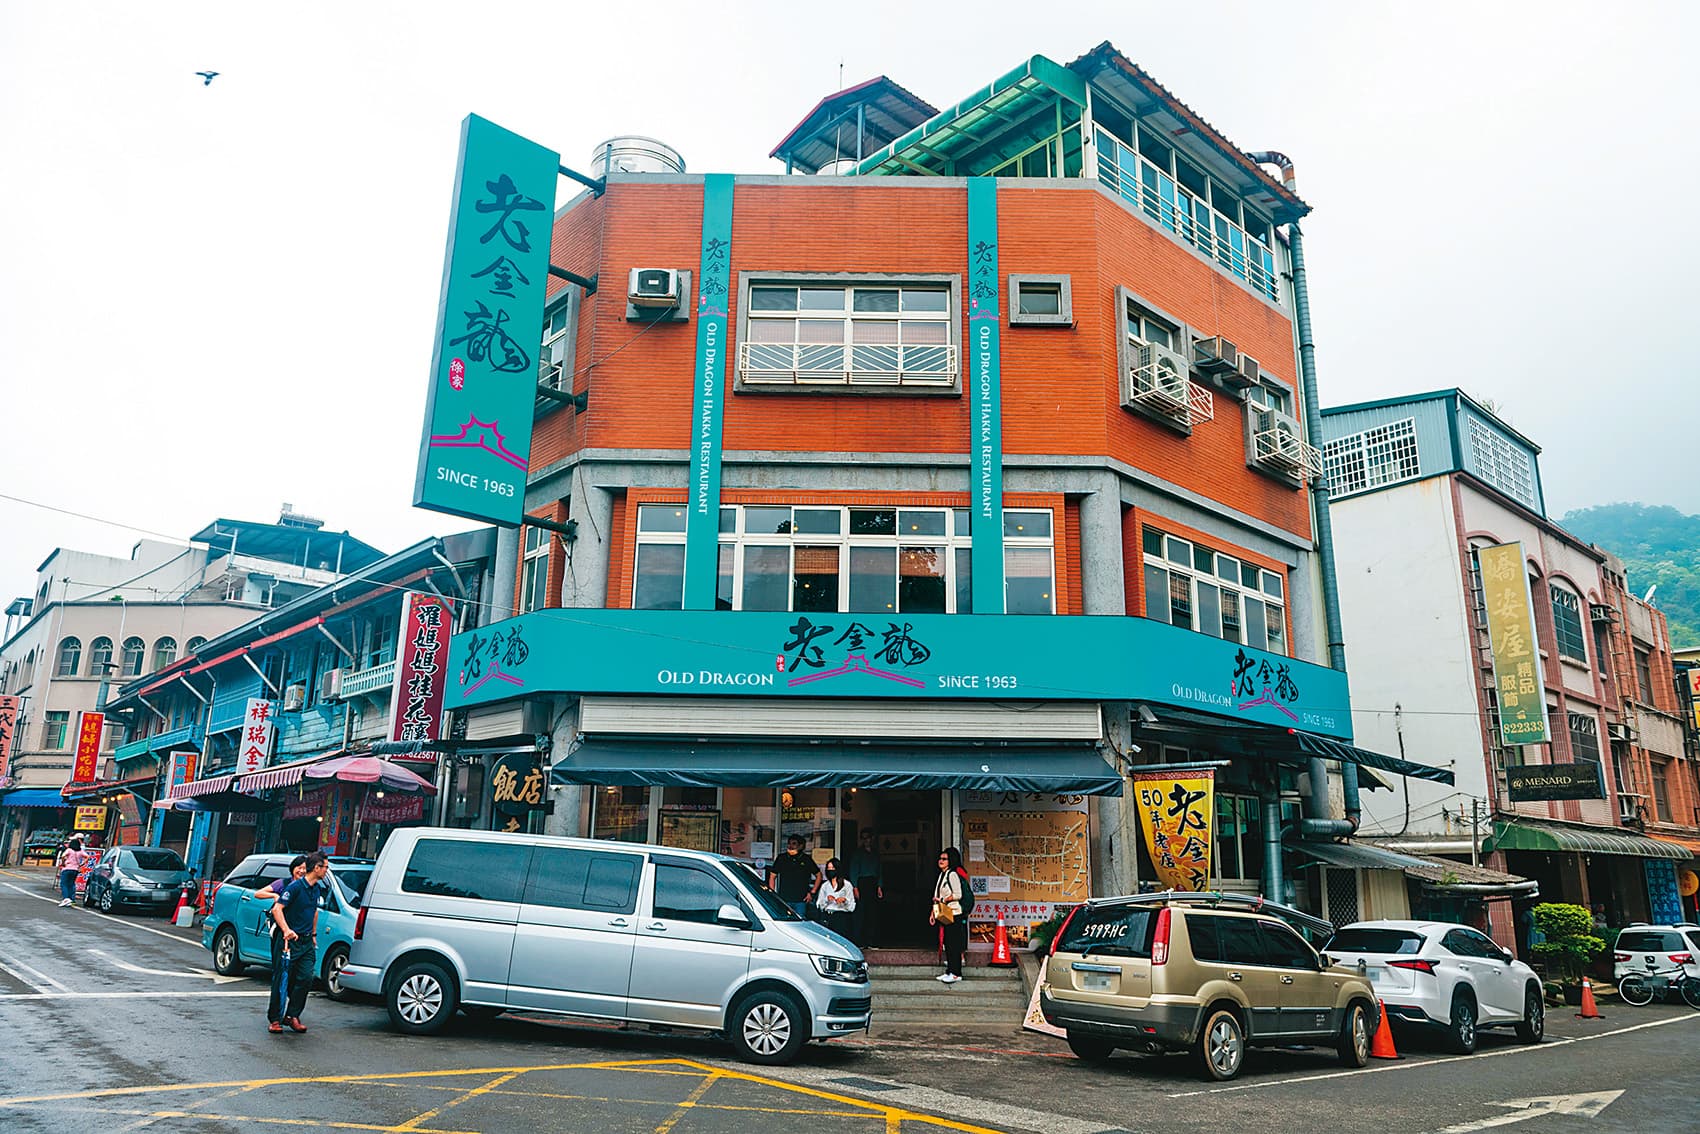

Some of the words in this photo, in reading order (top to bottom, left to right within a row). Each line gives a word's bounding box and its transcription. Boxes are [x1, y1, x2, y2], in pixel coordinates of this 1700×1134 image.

[450, 174, 546, 373] 老金龍
[701, 237, 729, 296] 老金龍
[972, 240, 998, 300] 老金龍
[701, 400, 713, 440] HAKKA
[981, 403, 992, 442] HAKKA
[436, 466, 478, 489] SINCE
[483, 479, 514, 497] 1963
[698, 441, 712, 515] RESTAURANT
[982, 445, 993, 520] RESTAURANT
[464, 624, 529, 686] 老金龍
[784, 616, 931, 673] 老金龍
[657, 670, 694, 684] OLD
[699, 670, 774, 686] DRAGON
[938, 675, 979, 688] SINCE
[984, 675, 1017, 689] 1963
[1233, 648, 1299, 703] 老金龍
[1501, 675, 1518, 707] 服飾
[1517, 662, 1536, 695] 精品
[1172, 683, 1193, 699] OLD
[1194, 687, 1232, 708] DRAGON
[1303, 712, 1321, 726] SINCE
[1503, 721, 1544, 734] 822333
[493, 764, 543, 804] 飯店
[1525, 776, 1572, 786] MENARD
